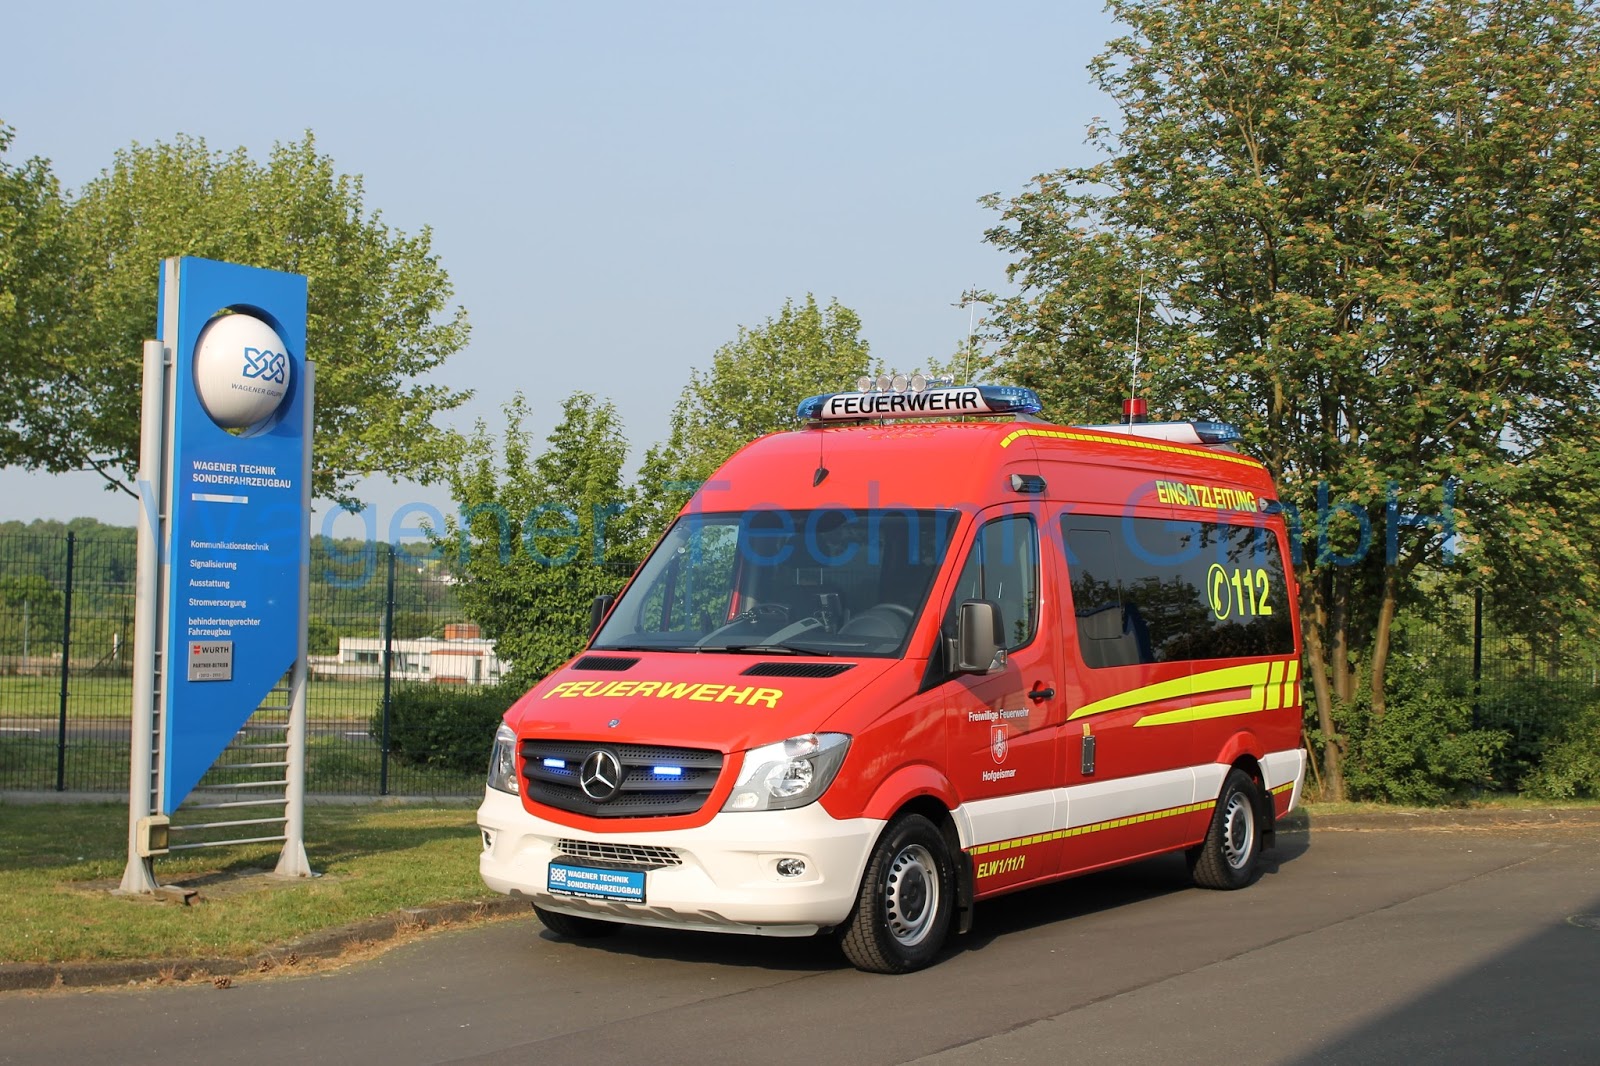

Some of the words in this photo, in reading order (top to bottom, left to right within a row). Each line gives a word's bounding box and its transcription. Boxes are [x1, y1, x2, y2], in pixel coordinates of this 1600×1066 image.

[231, 383, 266, 394] WAGENER
[831, 391, 978, 415] FEUERWEHR
[193, 461, 237, 473] WAGENER
[239, 464, 276, 475] TECHNIK
[192, 473, 291, 489] SONDERFAHRZEUGBAU
[1155, 480, 1258, 513] EINSATZLEITUNG
[190, 539, 270, 551] Kommunikationstechnik
[190, 559, 237, 570] Signalisierung
[189, 579, 230, 589] Ausstattung
[1231, 568, 1273, 616] 112
[188, 597, 247, 609] Stromversorgung
[188, 617, 261, 627] behindertengerechter
[188, 627, 231, 637] Fahrzeugbau
[542, 681, 783, 709] FEUERWEHR
[968, 710, 998, 722] Freiwillige
[1000, 708, 1029, 719] Feuerwehr
[982, 769, 1016, 782] Hofgeismar
[567, 870, 598, 881] WAGENER
[599, 873, 629, 884] TECHNIK
[567, 880, 641, 895] SONDERFAHRZEUGBAU
